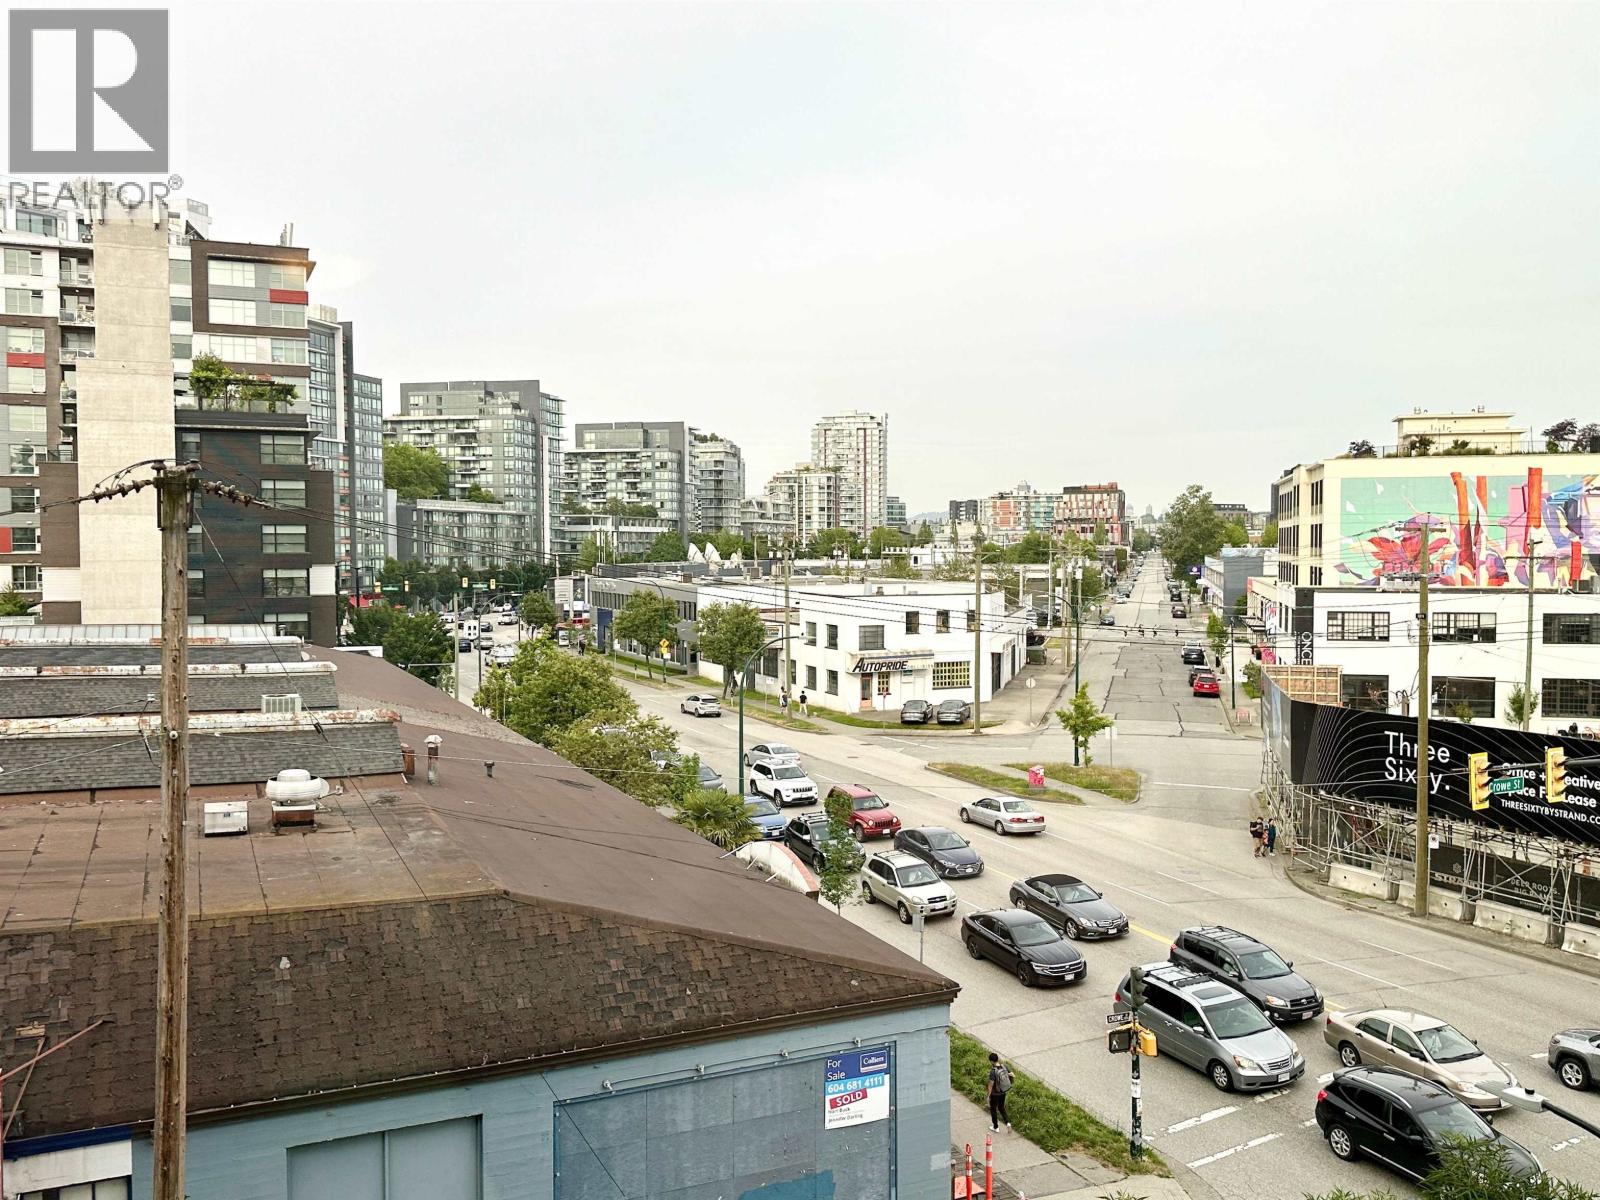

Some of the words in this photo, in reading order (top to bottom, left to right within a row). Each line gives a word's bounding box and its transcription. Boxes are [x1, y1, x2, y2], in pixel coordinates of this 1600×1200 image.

[852, 657, 908, 672] AUTOPRIDE
[1384, 757, 1450, 794] Sixy.
[1564, 774, 1600, 790] eative
[1489, 782, 1511, 792] Crowe
[1513, 779, 1520, 789] St
[827, 1059, 842, 1068] For
[863, 1056, 884, 1065] Colliers
[827, 1070, 846, 1081] Sale
[828, 1084, 844, 1093] 604
[846, 1081, 862, 1091] 681
[864, 1076, 882, 1088] 4111
[836, 1091, 863, 1106] SOLD
